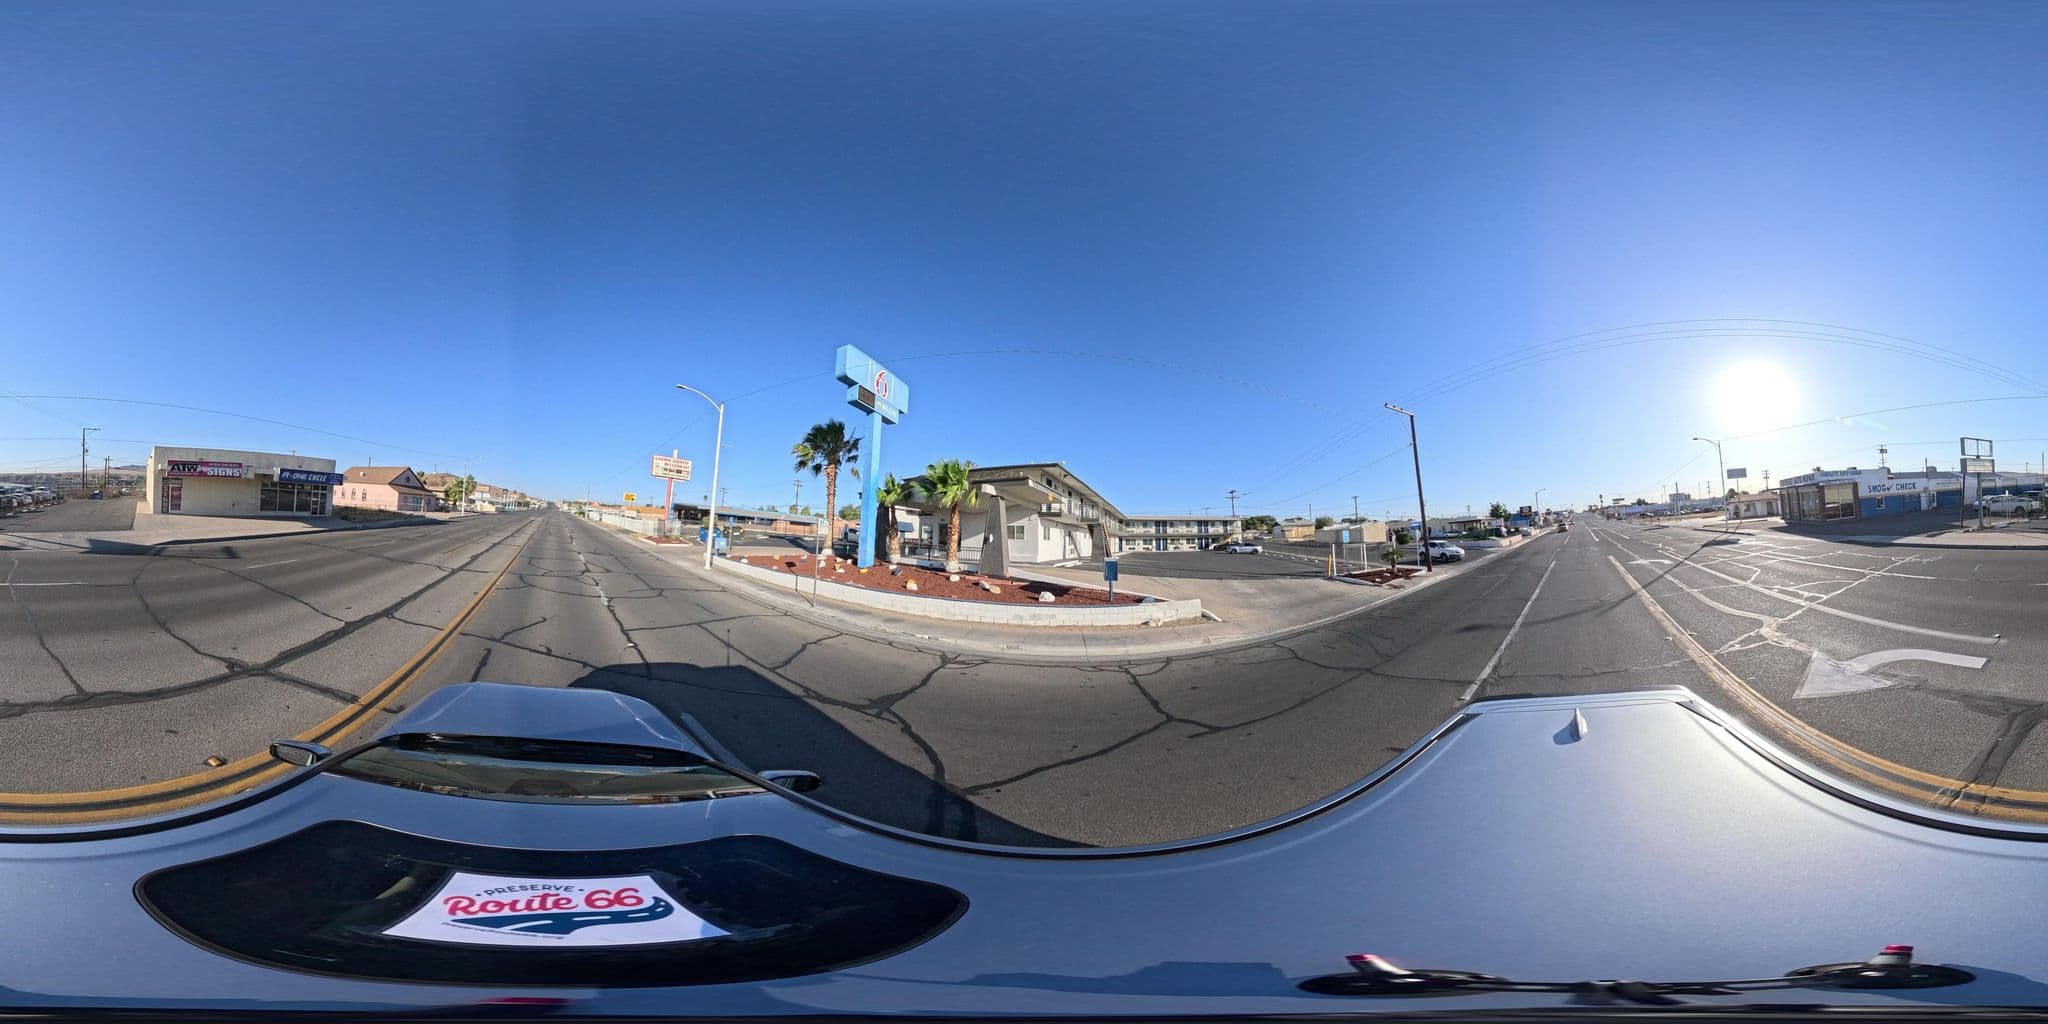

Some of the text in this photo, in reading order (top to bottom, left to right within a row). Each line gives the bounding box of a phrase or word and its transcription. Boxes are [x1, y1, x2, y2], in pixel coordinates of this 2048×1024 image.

[874, 369, 889, 399] 6
[207, 467, 242, 477] SIGNS
[1867, 482, 1917, 493] SMOG CHECK
[484, 884, 574, 896] PRESERVE
[443, 887, 645, 916] Route 66
